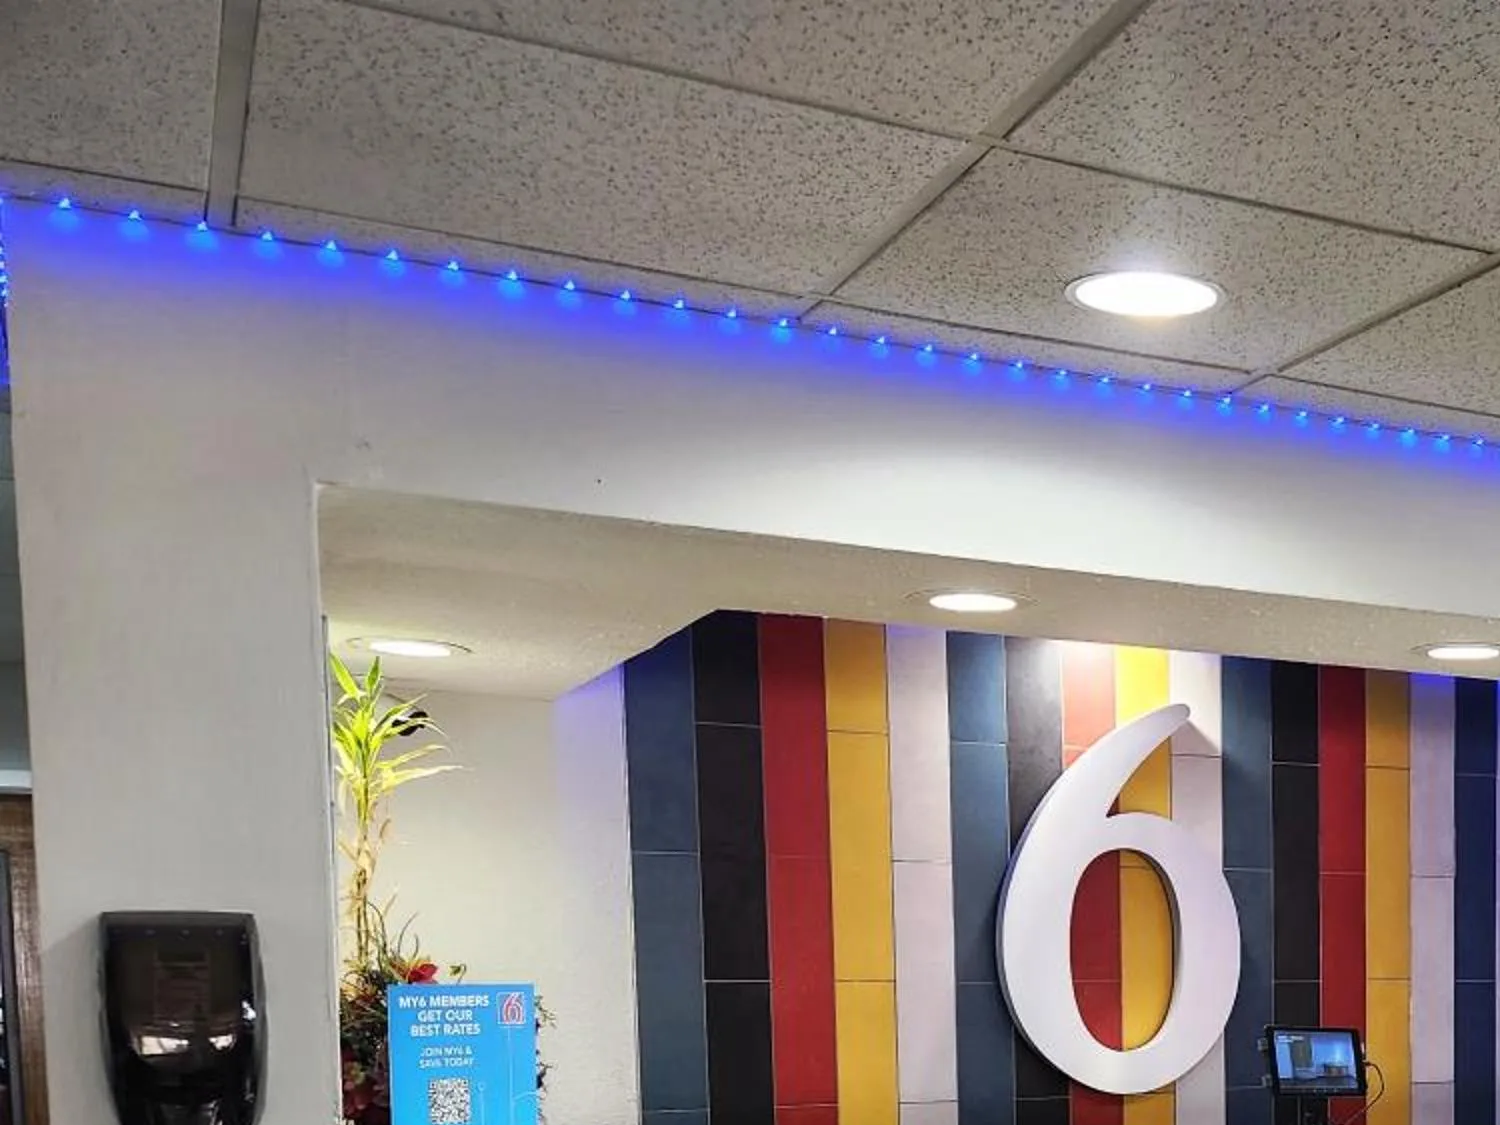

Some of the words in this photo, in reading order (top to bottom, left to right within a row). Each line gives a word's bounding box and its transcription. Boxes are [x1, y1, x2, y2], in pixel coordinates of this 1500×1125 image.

[996, 703, 1242, 1095] 6
[399, 995, 426, 1008] MY6
[429, 994, 490, 1007] MEMBERS
[417, 1009, 442, 1022] GET
[445, 1009, 473, 1021] OUR
[410, 1024, 440, 1037] BEST
[443, 1023, 481, 1036] RATES
[420, 1046, 442, 1057] JOIN
